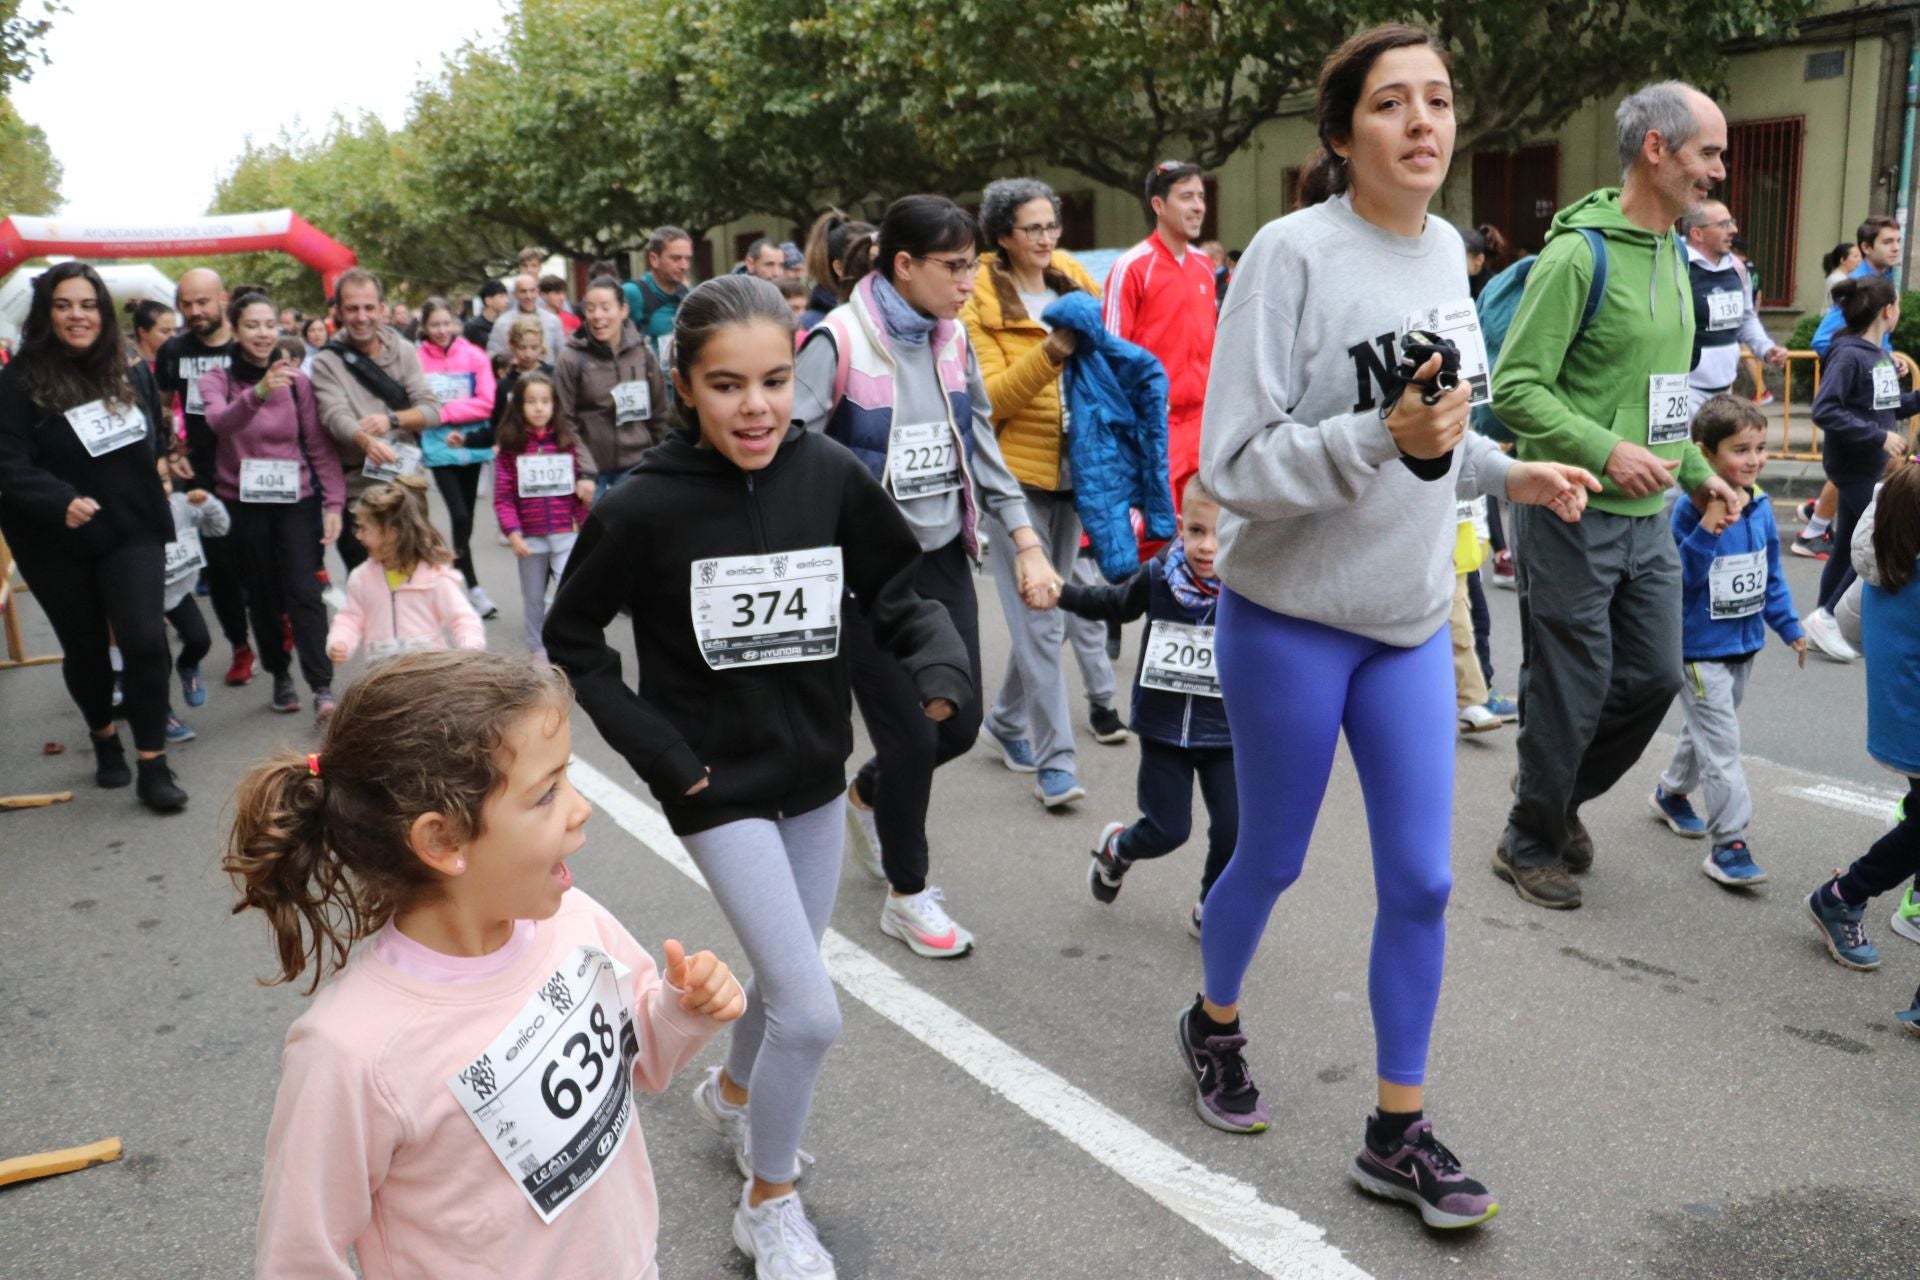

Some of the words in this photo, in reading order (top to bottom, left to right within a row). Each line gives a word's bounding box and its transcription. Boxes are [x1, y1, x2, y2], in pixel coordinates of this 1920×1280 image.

[83, 227, 181, 239] AYUNTAMIENTO
[184, 226, 199, 237] DE
[1720, 303, 1739, 317] 130
[90, 413, 127, 436] 373
[903, 443, 952, 472] 2227
[255, 474, 285, 488] 404
[528, 468, 564, 483] 3107
[1731, 569, 1764, 595] 632
[731, 587, 808, 629] 374
[760, 646, 802, 659] HYUNDAI
[1161, 642, 1213, 670] 209
[540, 1002, 615, 1120] 638
